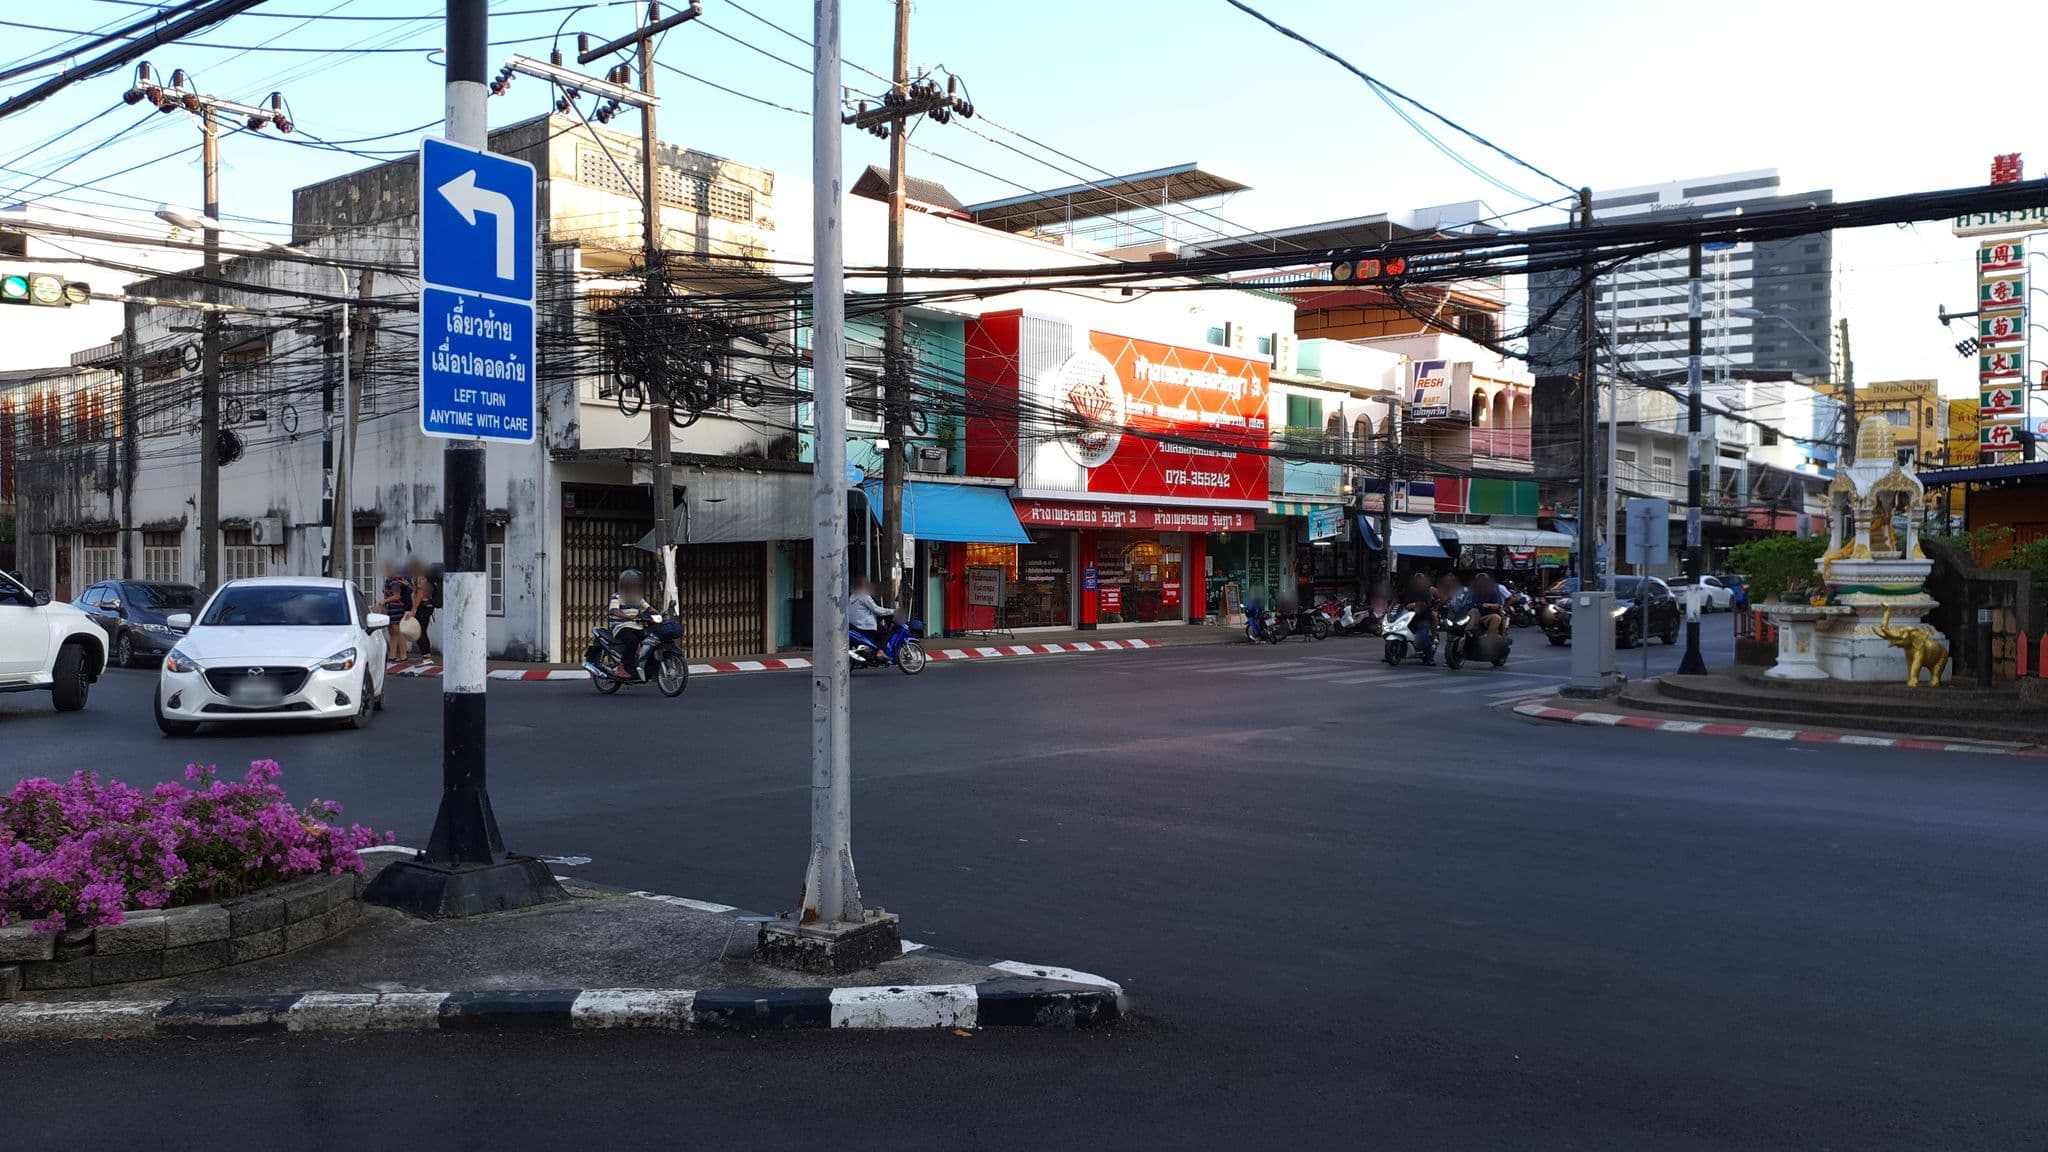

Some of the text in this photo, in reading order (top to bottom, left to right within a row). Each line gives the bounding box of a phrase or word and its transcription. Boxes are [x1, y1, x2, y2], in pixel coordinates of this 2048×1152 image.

[446, 295, 513, 342] เลี้ยวซ้าย
[431, 336, 526, 383] เมื่อปลอดภัย
[453, 388, 506, 408] LEFT TURN
[429, 408, 528, 432] ANYTIME WITH CARE
[1164, 469, 1231, 489] 076-355242
[1129, 509, 1137, 523] 3
[1235, 514, 1242, 526] 3
